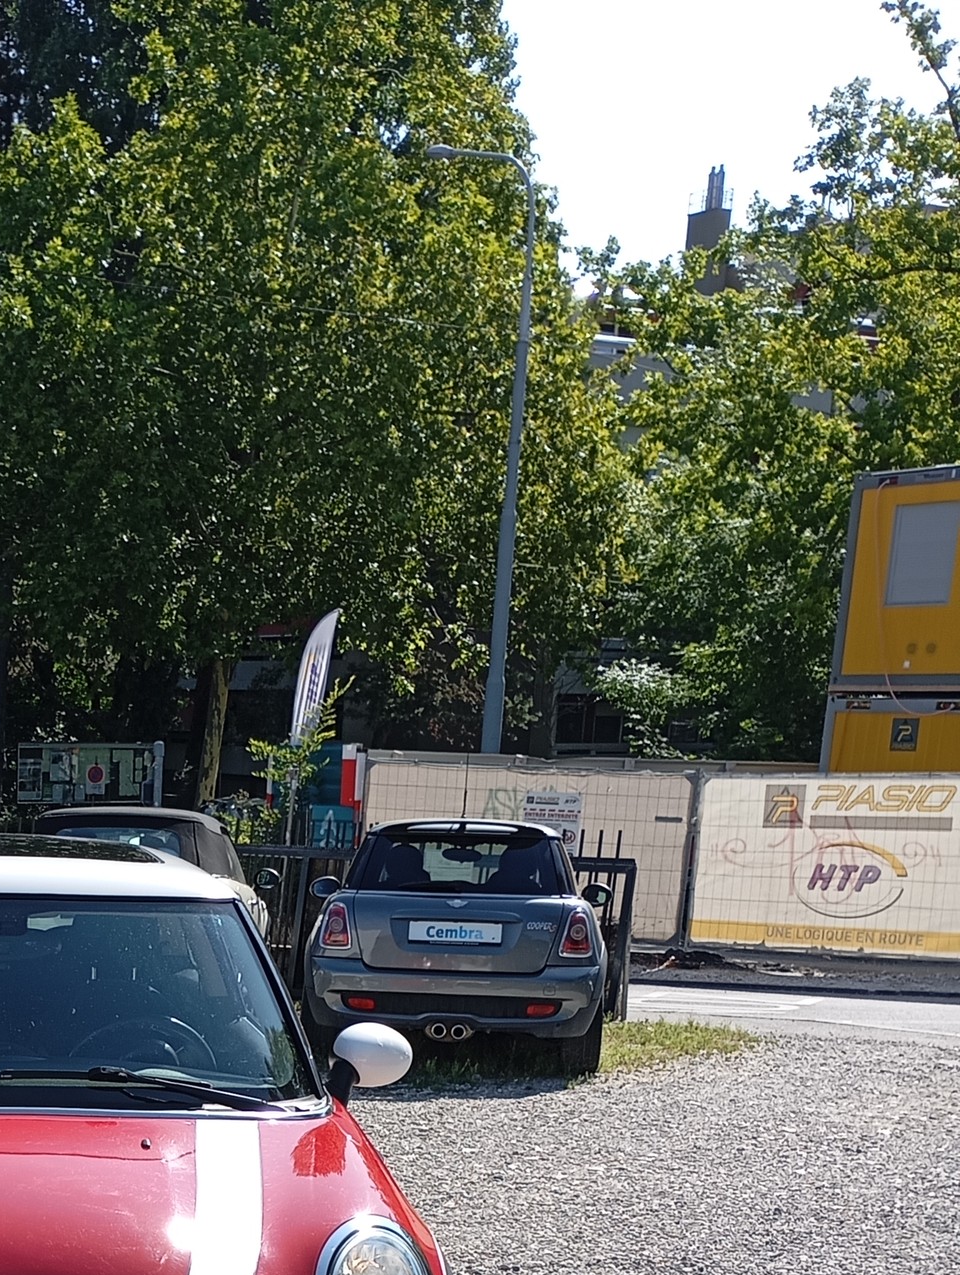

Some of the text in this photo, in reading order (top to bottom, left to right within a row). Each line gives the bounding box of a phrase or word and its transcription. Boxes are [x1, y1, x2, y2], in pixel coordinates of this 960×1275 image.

[811, 784, 957, 813] PIASIO
[807, 863, 881, 892] HTP
[426, 925, 483, 940] Cembra
[766, 926, 924, 946] UNE LOGIQUE EN ROUTE
